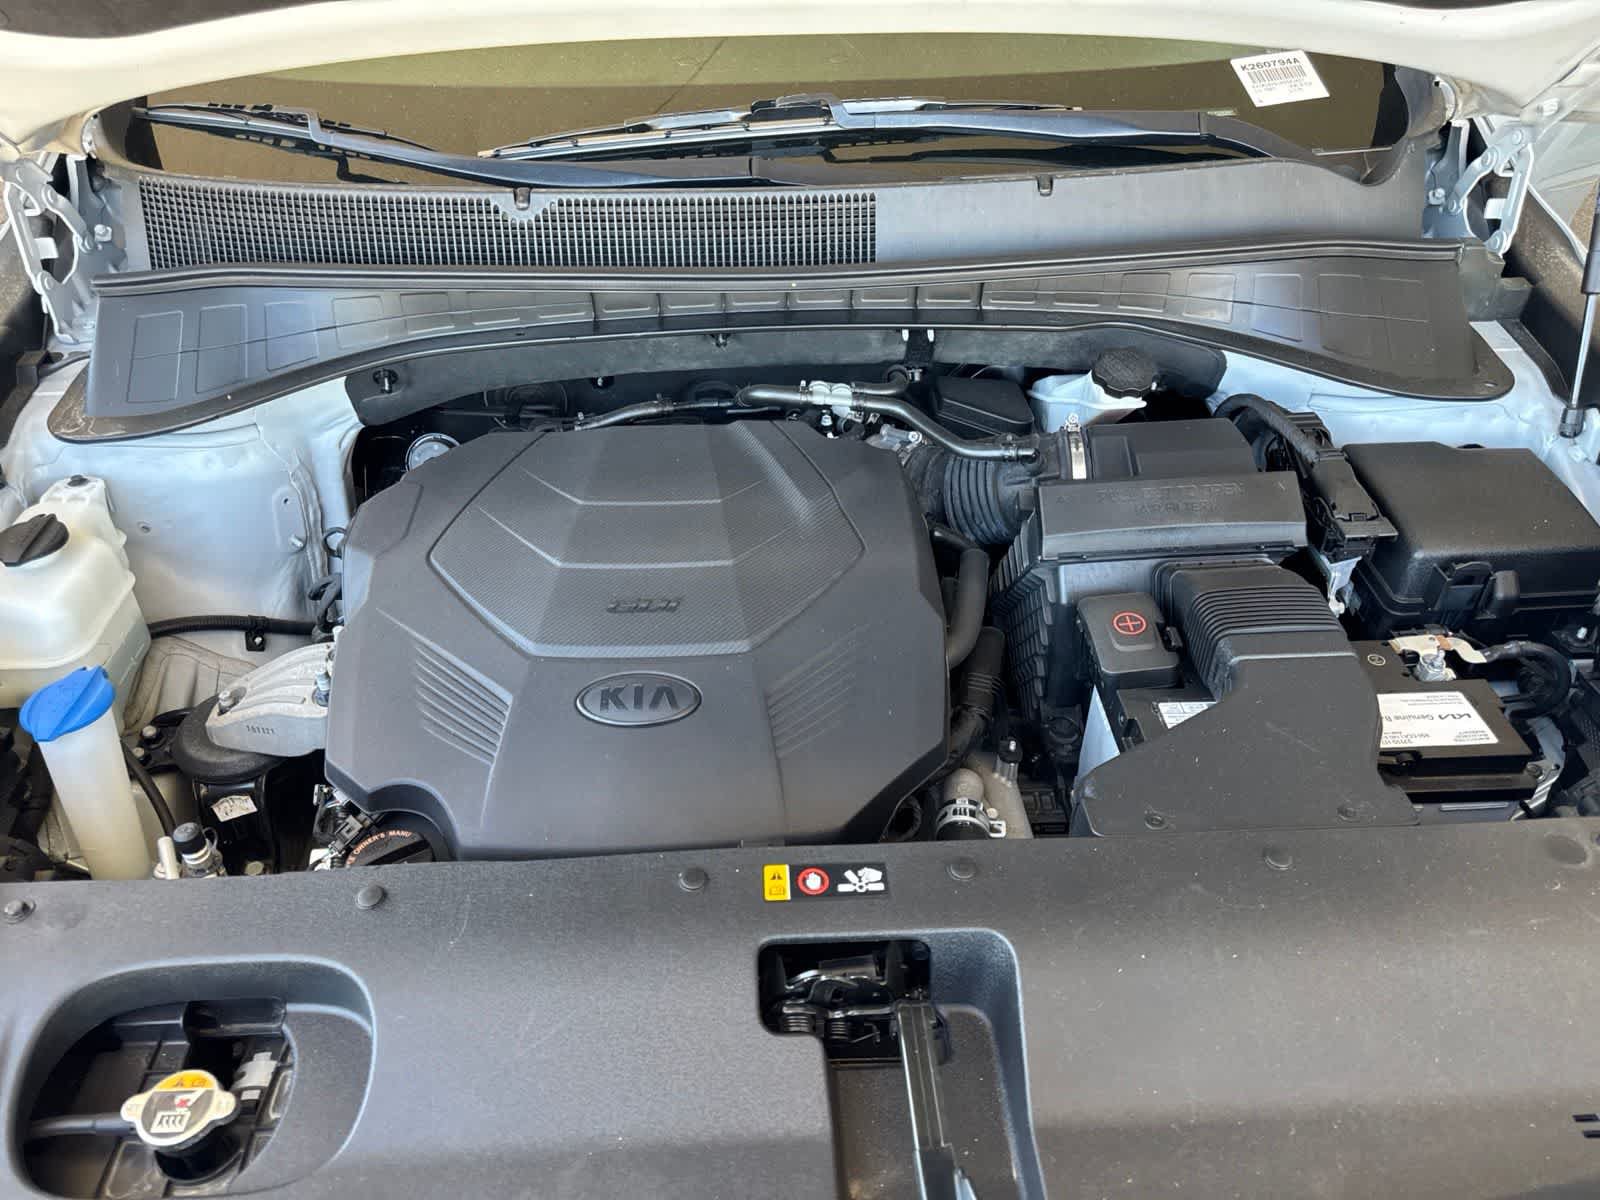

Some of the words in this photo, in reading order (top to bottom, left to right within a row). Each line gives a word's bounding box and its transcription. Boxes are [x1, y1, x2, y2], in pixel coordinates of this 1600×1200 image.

[1240, 57, 1301, 71] K260794A
[600, 684, 680, 712] KIA
[352, 832, 386, 856] OWNER'S
